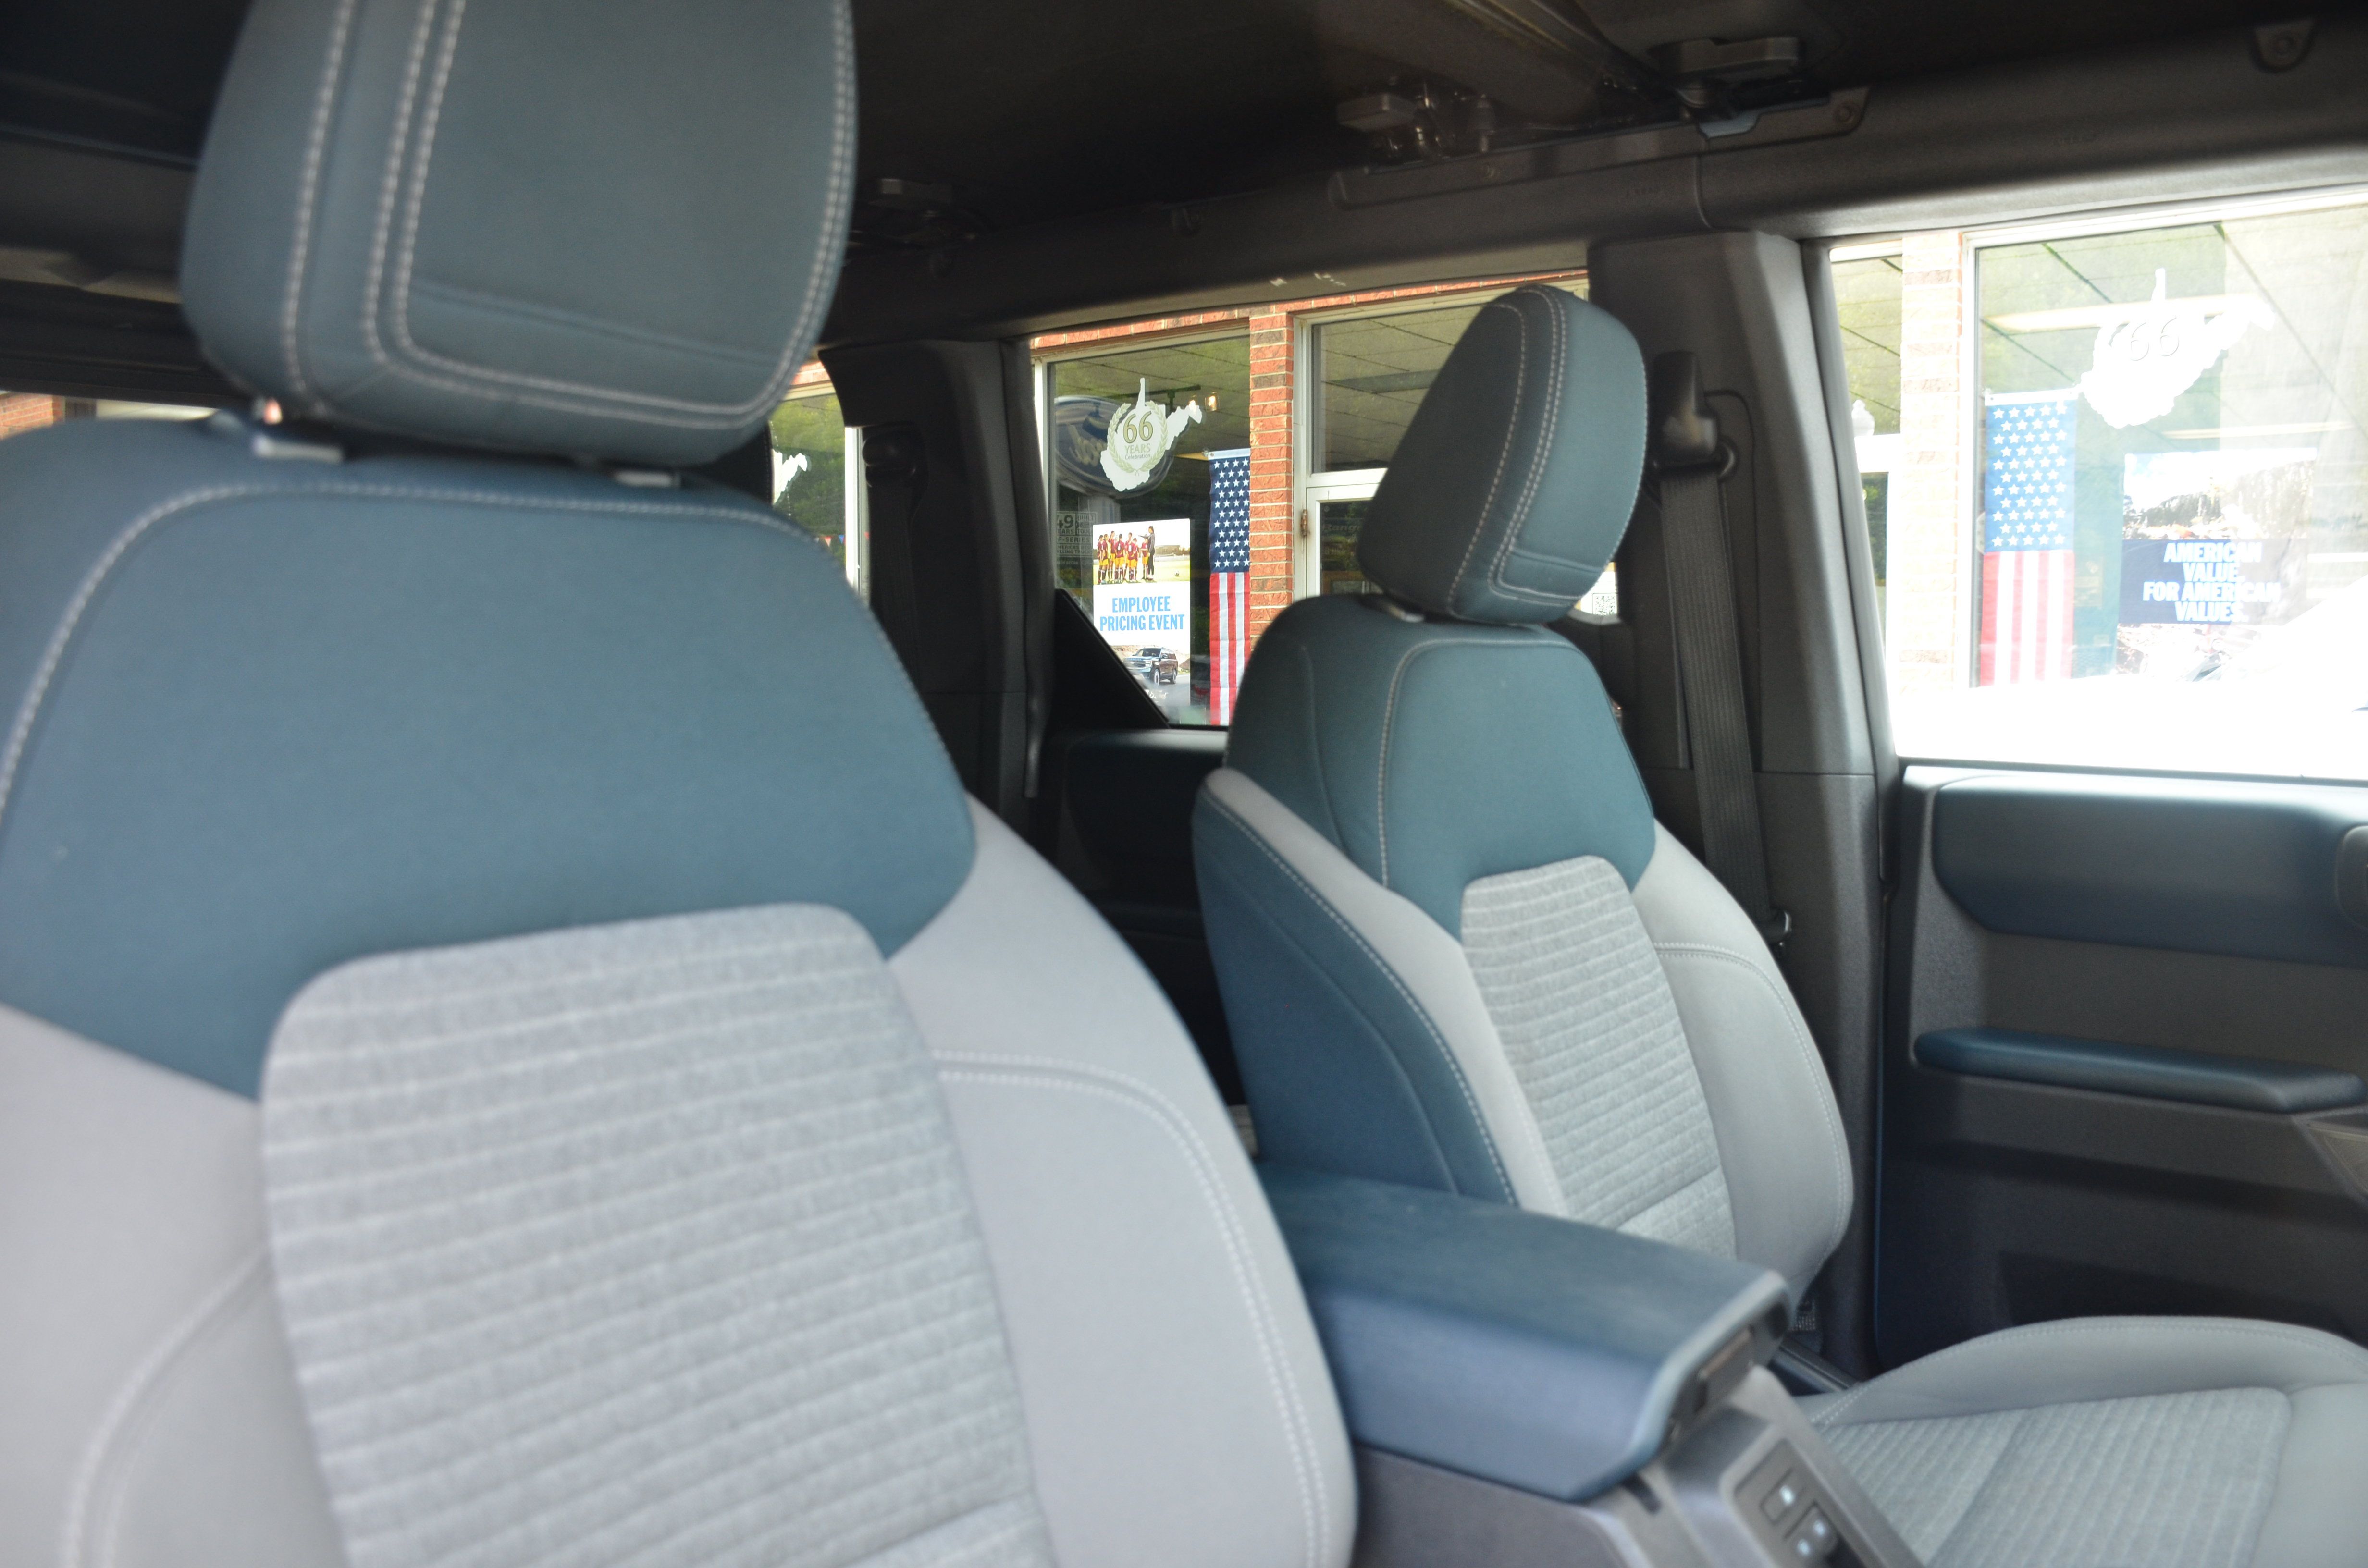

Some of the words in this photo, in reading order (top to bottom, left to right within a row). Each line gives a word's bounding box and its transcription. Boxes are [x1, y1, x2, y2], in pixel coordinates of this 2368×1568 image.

[2129, 315, 2180, 361] 66
[1123, 411, 1153, 443] 66
[1125, 443, 1151, 454] YEARS
[2163, 542, 2261, 563] AMERICAN
[2183, 562, 2245, 582] VALUE.
[2143, 581, 2180, 601] FOR
[2181, 581, 2281, 602] AMERICAN
[1112, 596, 1171, 612] EMPLOYEE
[2174, 601, 2248, 622] VALUES.
[1100, 615, 1146, 631] PRICING
[1149, 614, 1184, 630] EVENT
